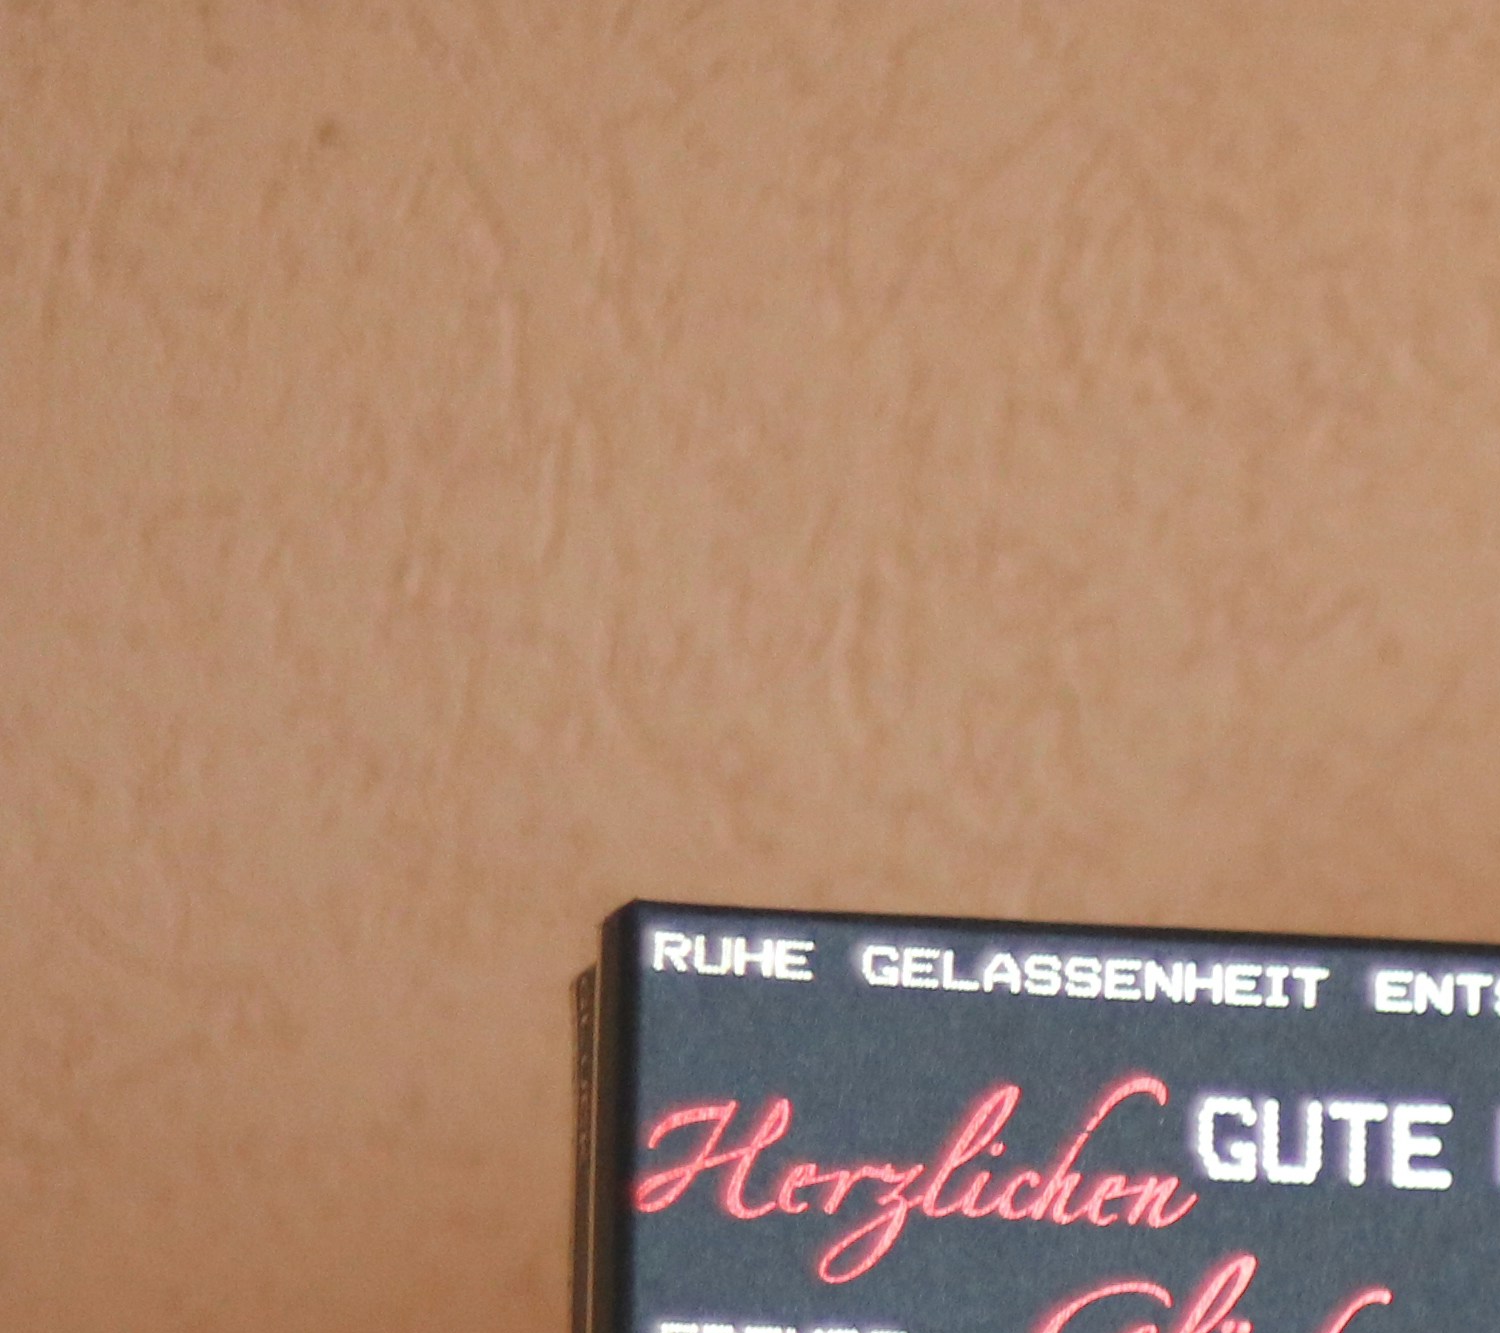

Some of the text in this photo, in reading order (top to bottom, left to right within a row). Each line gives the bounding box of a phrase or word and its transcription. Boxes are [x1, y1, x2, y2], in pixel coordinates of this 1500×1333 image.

[650, 930, 814, 983] RUHE
[858, 944, 1331, 1009] GELASSENHEIT
[634, 1077, 1197, 1287] Herzlichen
[1198, 1095, 1455, 1192] GUTE
